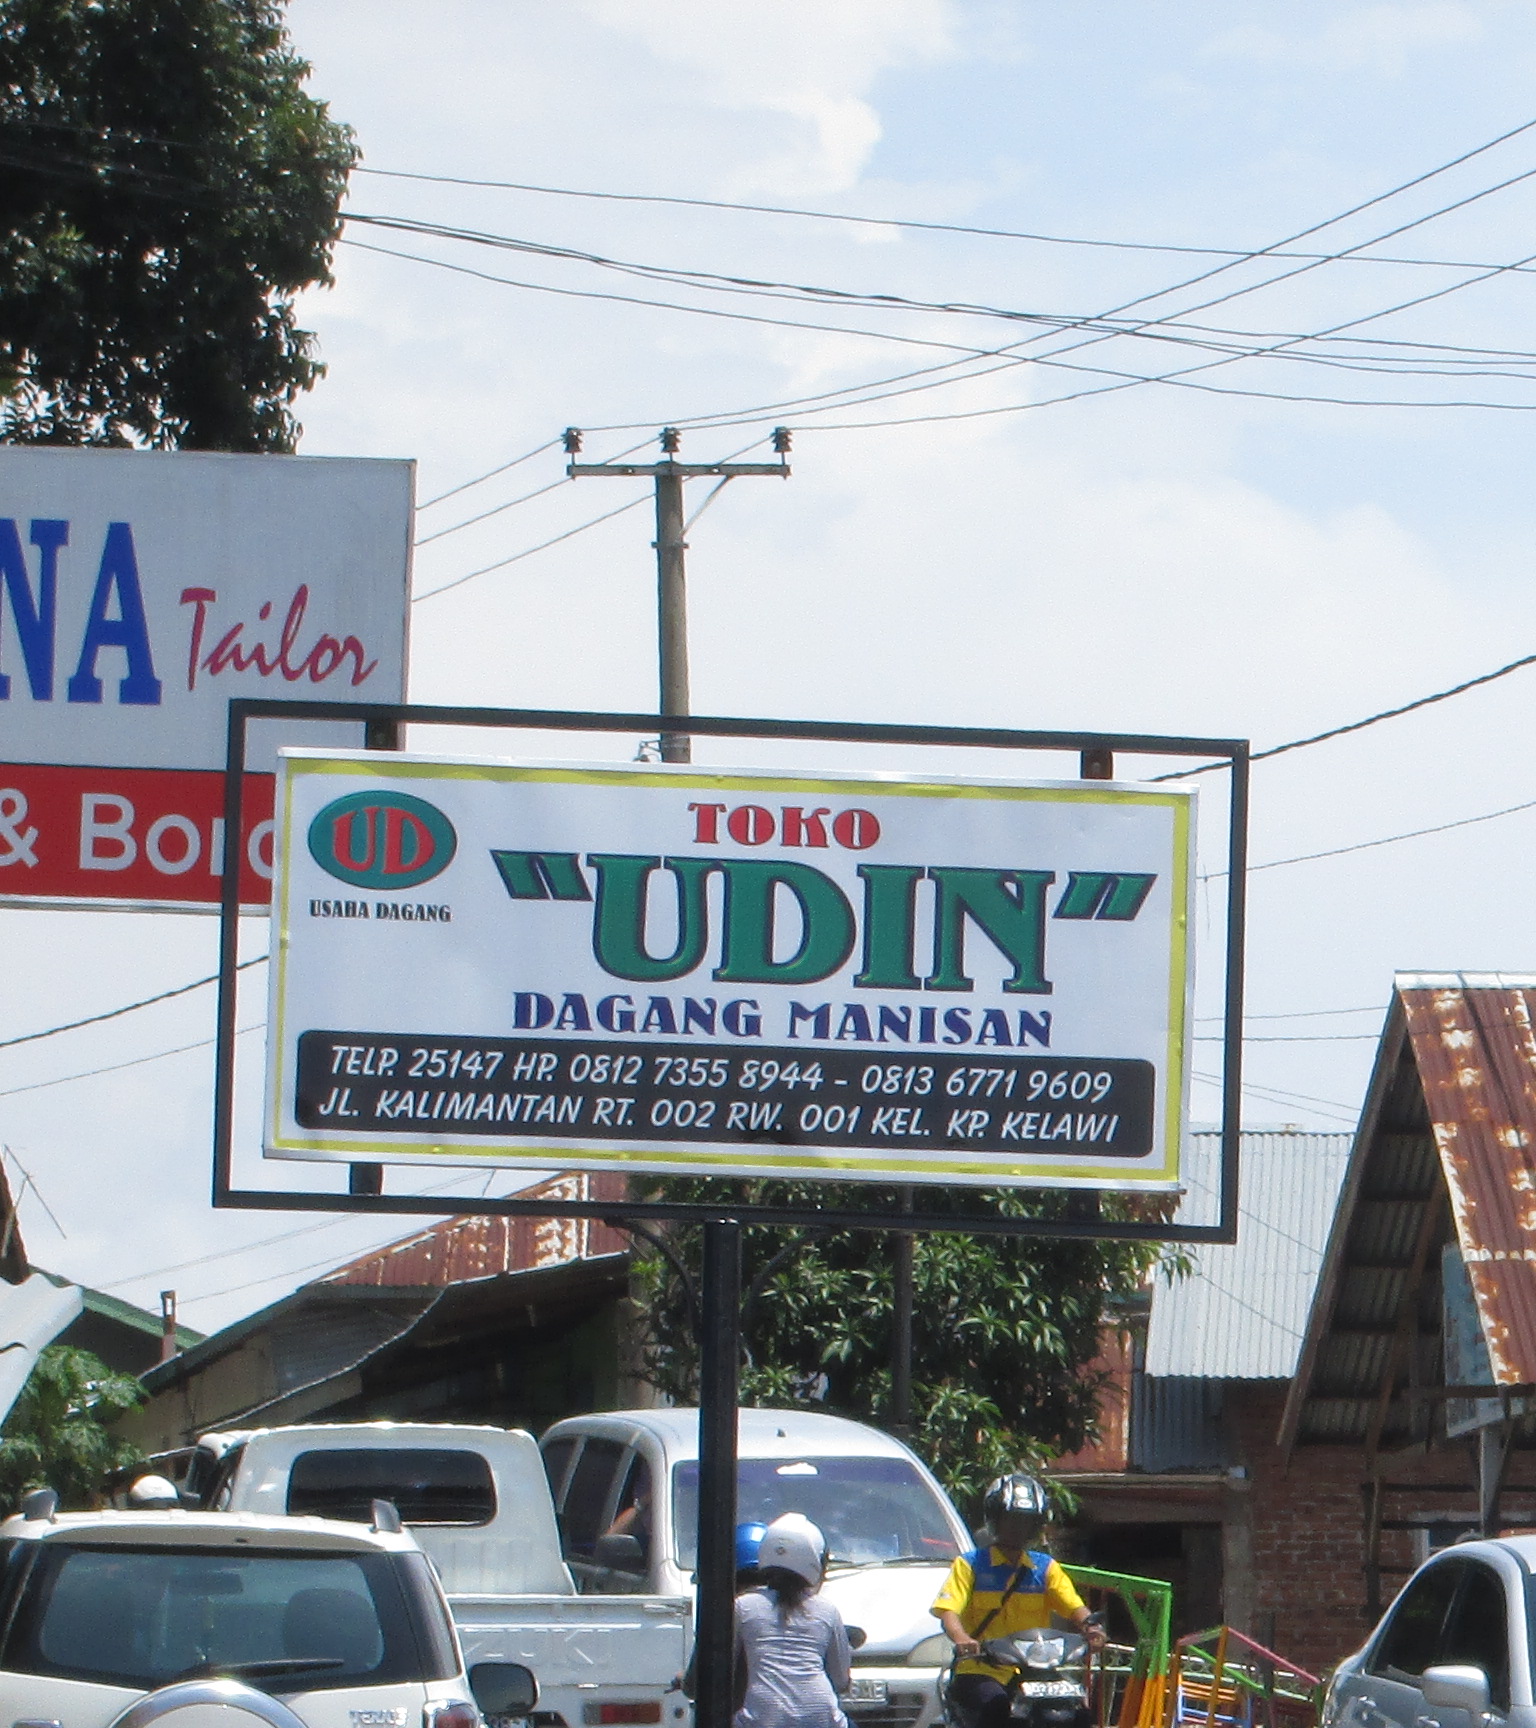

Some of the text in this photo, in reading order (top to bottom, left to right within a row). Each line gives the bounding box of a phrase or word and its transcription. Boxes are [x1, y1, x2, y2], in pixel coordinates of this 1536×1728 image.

[180, 583, 379, 691] Tailor
[331, 806, 437, 875] UD
[688, 802, 882, 850] TOKO
[308, 899, 452, 923] USAHA DAGANG
[512, 992, 1053, 1049] DAGANG MANISAN
[330, 1044, 397, 1077] TELP.
[408, 1049, 503, 1079] 25147
[512, 1053, 558, 1082] HP.
[569, 1054, 643, 1085] 0812
[653, 1057, 728, 1088] 7355
[738, 1060, 824, 1092] 8944
[861, 1064, 934, 1095] 0813
[946, 1066, 1017, 1099] 6771
[1026, 1069, 1113, 1103] 9609
[319, 1087, 1121, 1143] JL. KALIMANTAN RT. 002 RW. 001 KEL. KP. KELAWI
